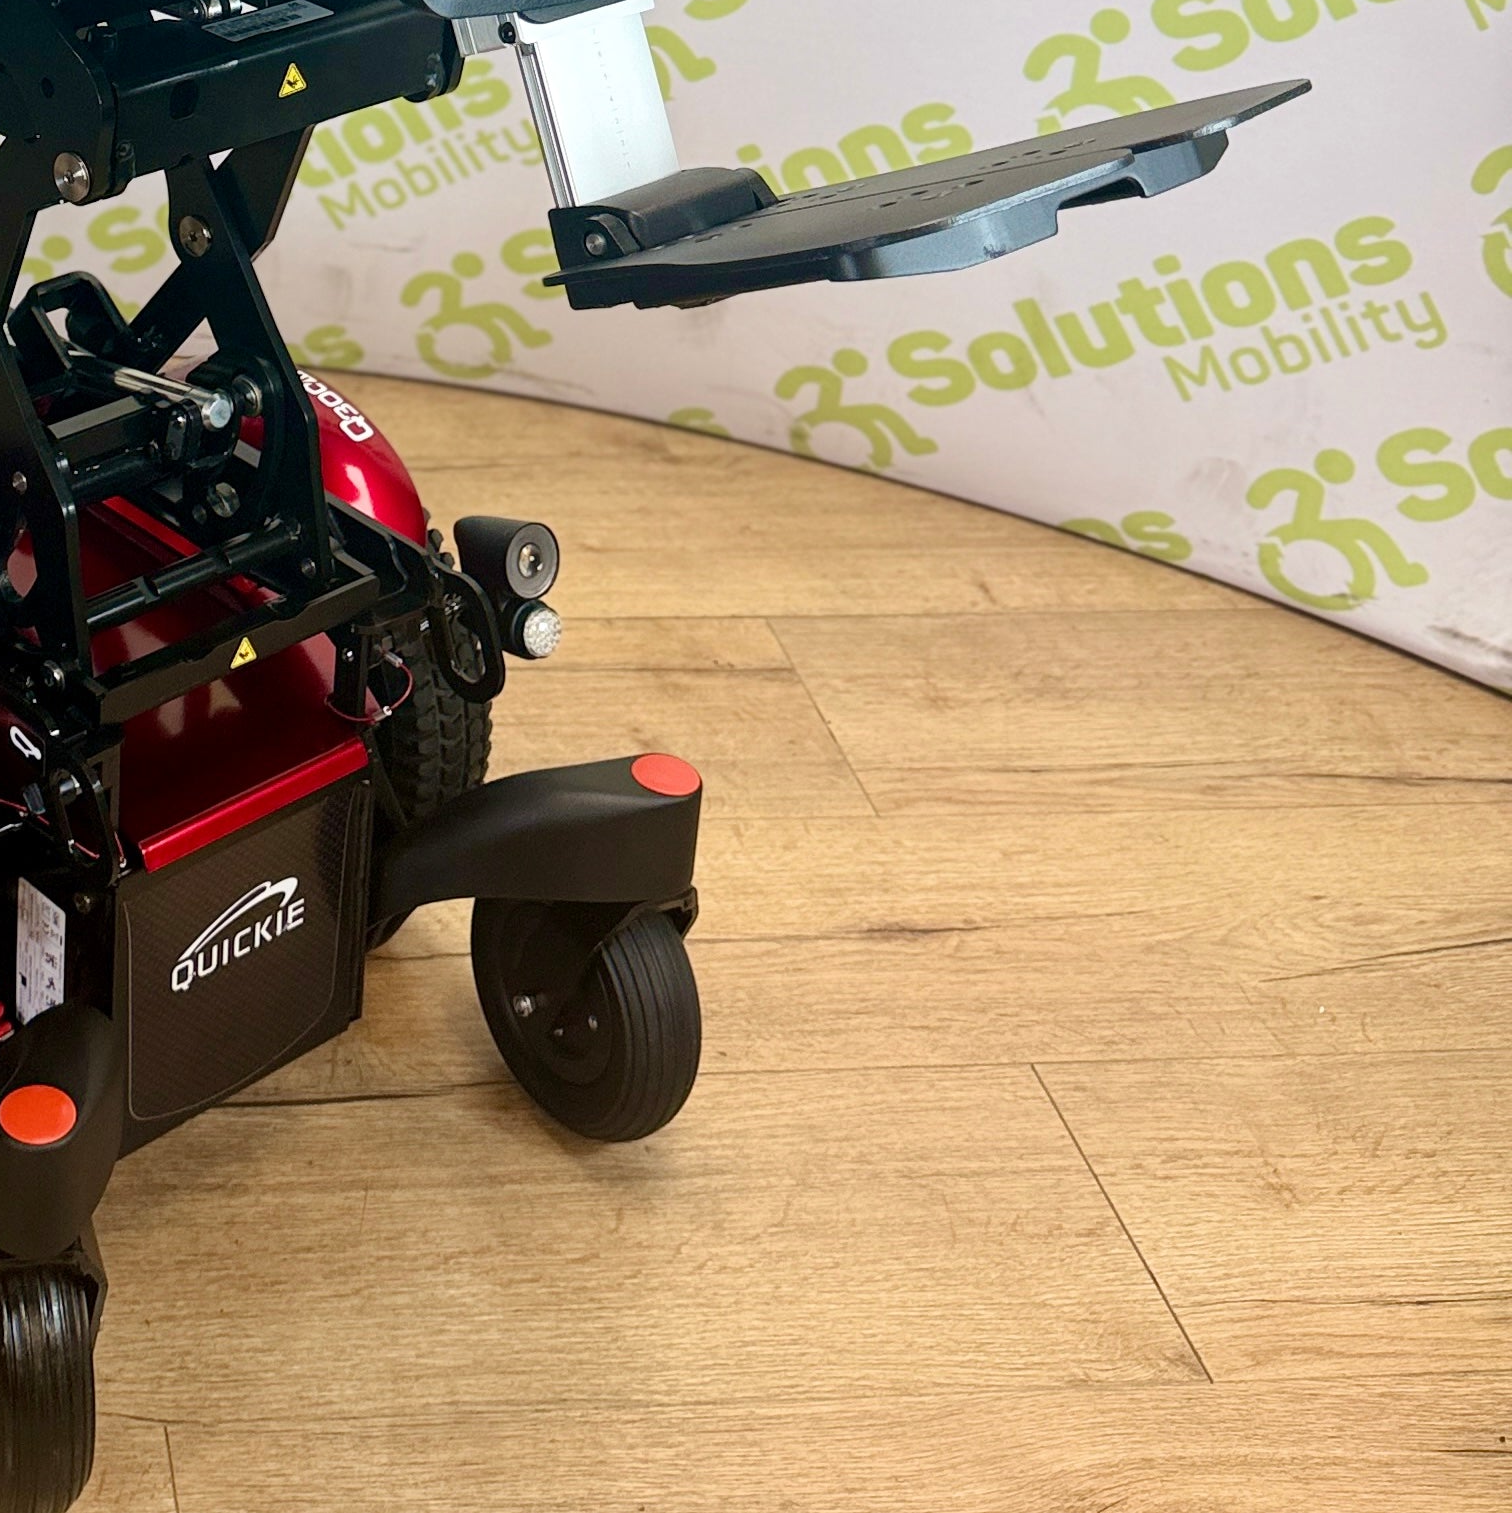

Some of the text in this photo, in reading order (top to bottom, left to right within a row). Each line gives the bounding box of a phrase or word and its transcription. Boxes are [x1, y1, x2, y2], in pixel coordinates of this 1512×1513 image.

[886, 215, 1414, 408] Solutions
[1163, 291, 1449, 403] Mobility
[171, 897, 305, 992] QUICKIE
